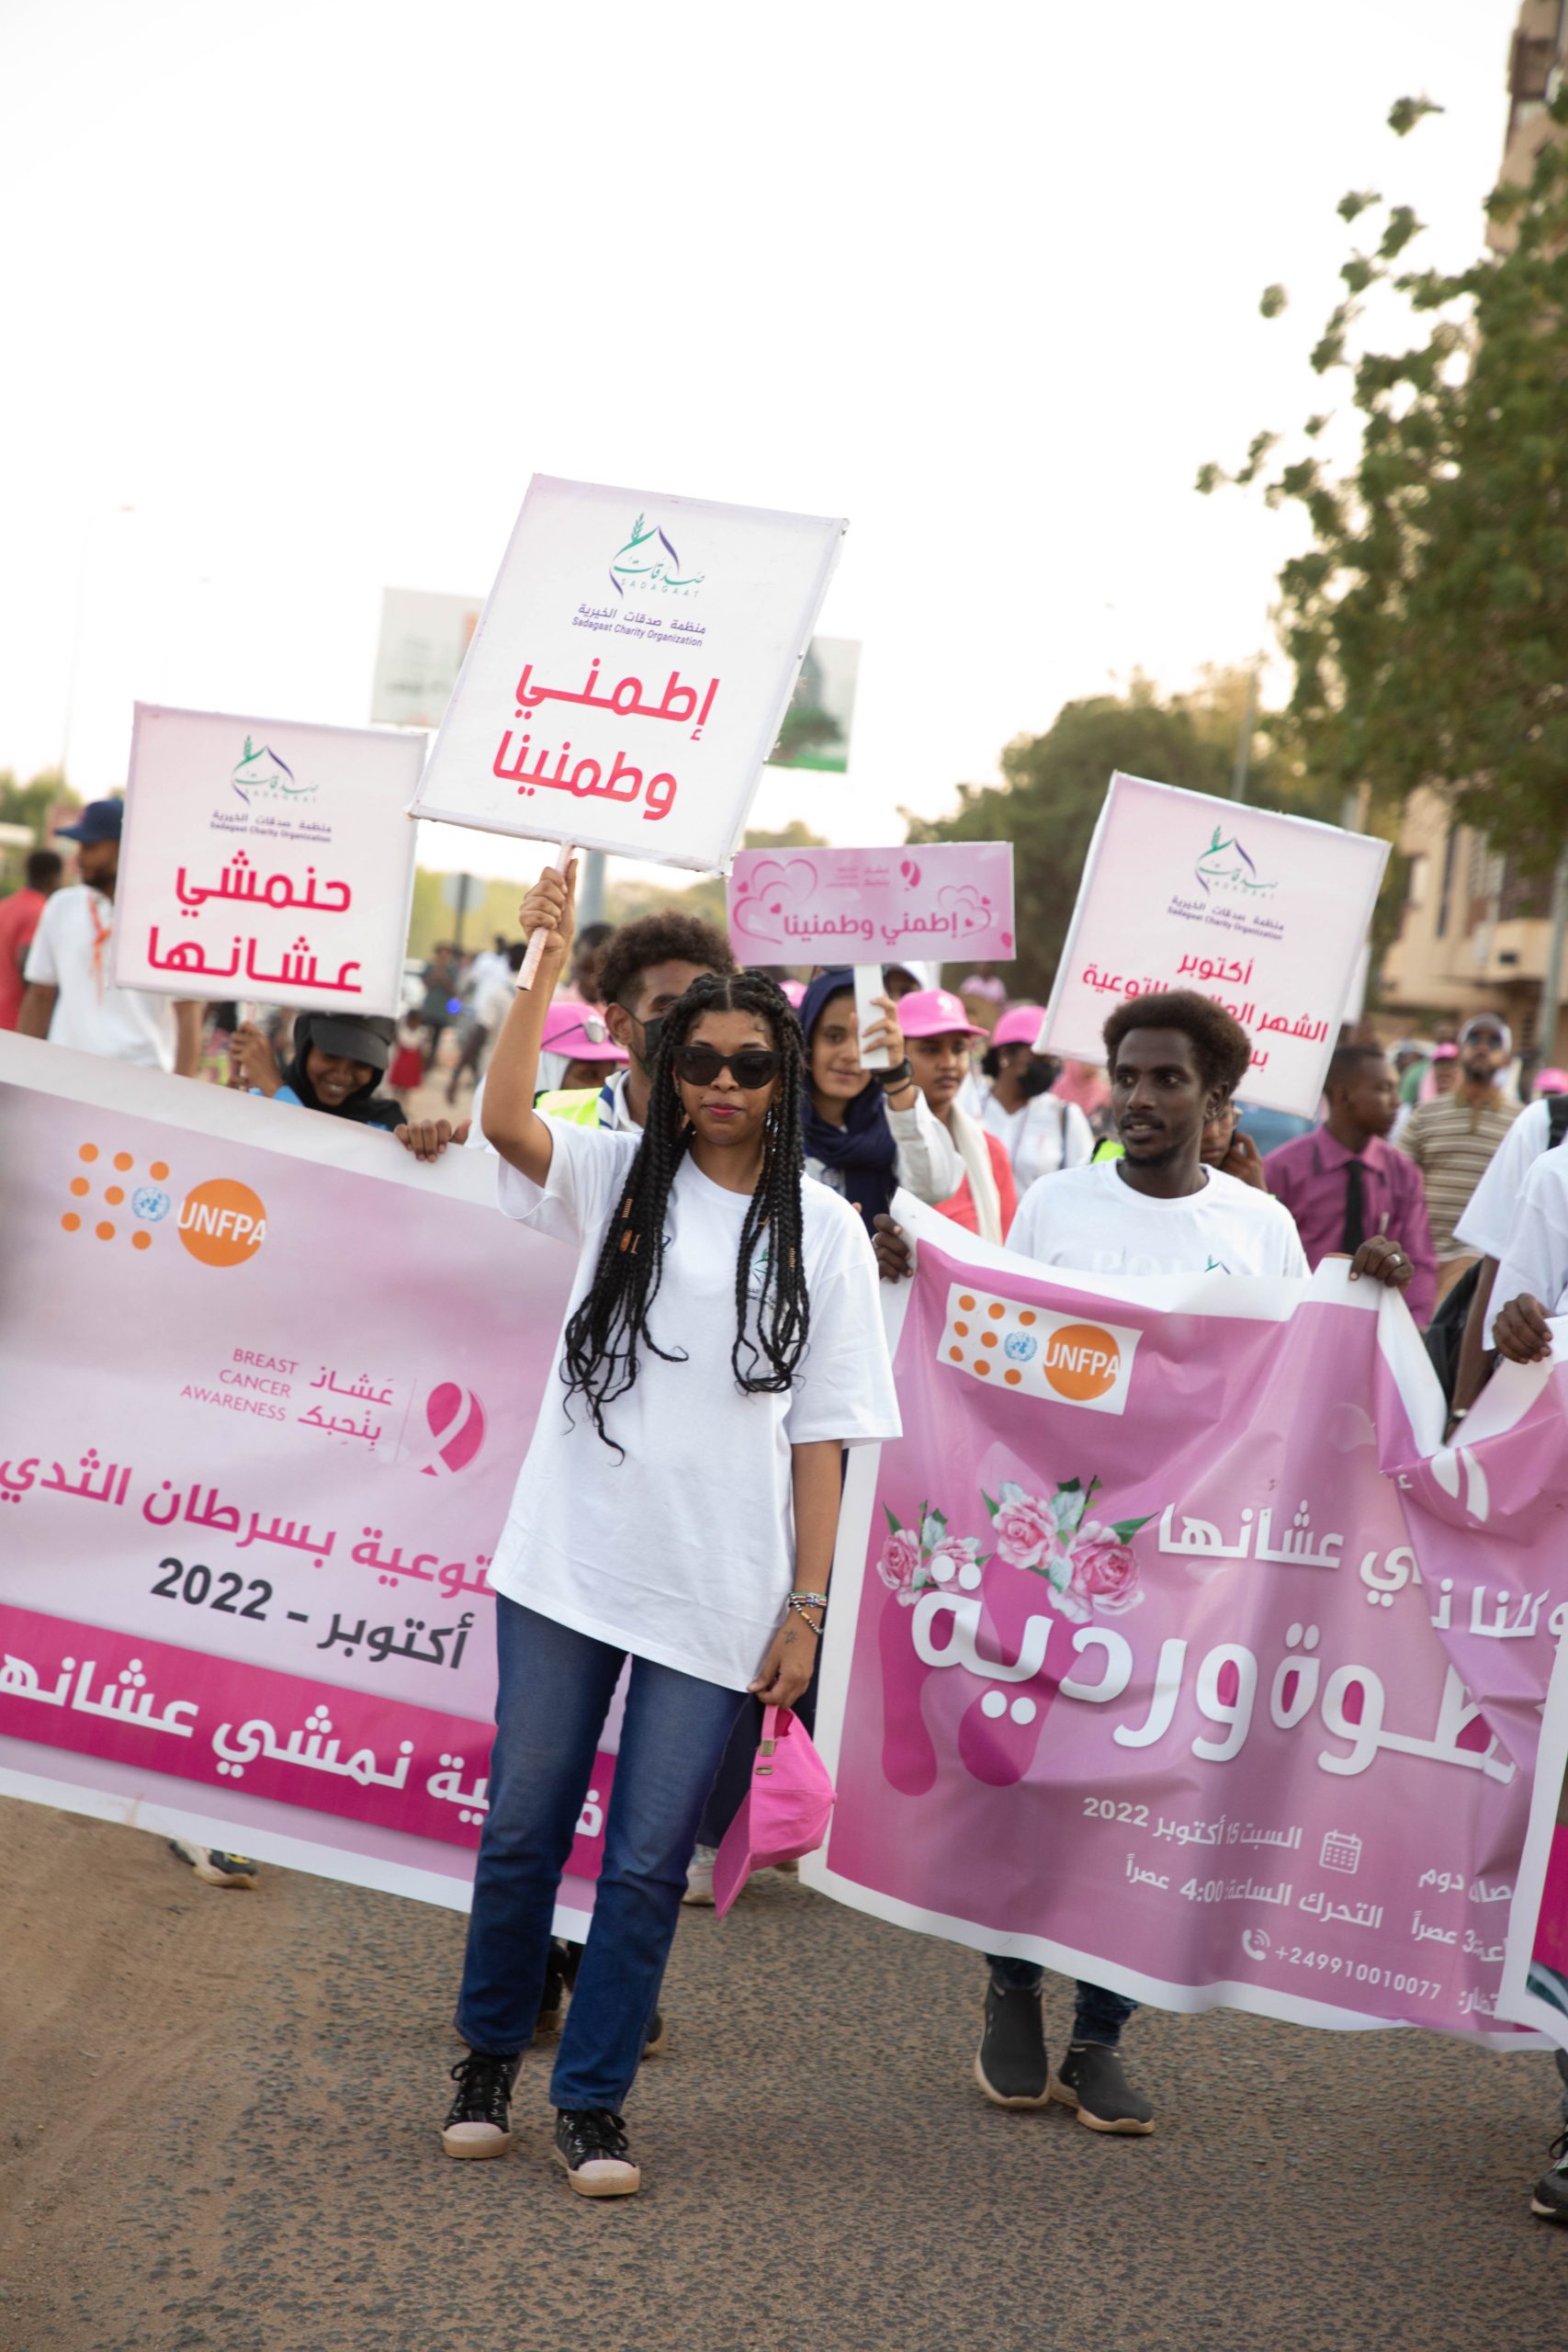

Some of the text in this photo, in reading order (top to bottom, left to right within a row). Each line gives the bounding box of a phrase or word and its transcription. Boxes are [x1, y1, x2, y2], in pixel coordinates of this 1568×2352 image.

[571, 616, 704, 647] Sadagaat Charity Organization
[578, 604, 706, 634] منظمة صدقات الخيرية
[515, 657, 720, 741] إطمني
[492, 730, 678, 820] وطمنينا
[175, 850, 352, 918] حنمشي
[783, 911, 957, 945] إطمني وطمنينا
[148, 926, 362, 993] عشانها
[1177, 954, 1255, 985] أكتوبر
[1256, 1012, 1329, 1044] الشهر
[176, 1199, 267, 1247] UNFPA
[232, 1348, 299, 1375] BREAST
[1043, 1342, 1121, 1378] UNFPA
[219, 1369, 291, 1399] CANCER
[180, 1385, 287, 1421] AWARENESS
[0, 1448, 497, 1600] توعية بسرطان الثدي
[1157, 1499, 1344, 1568] عشانها
[150, 1557, 274, 1622] 2022
[316, 1611, 476, 1669] أكتوبر
[911, 1555, 1258, 1762] وردية
[0, 1654, 199, 1738] عشانه
[211, 1705, 414, 1790] نمشي
[1082, 1797, 1150, 1827] 2022
[1153, 1815, 1227, 1846] أكتوبر
[1239, 1822, 1303, 1849] السبت
[1418, 1869, 1465, 1893] دوم
[1299, 1892, 1384, 1929] التحرك
[1274, 1945, 1442, 2001] +249910010077
